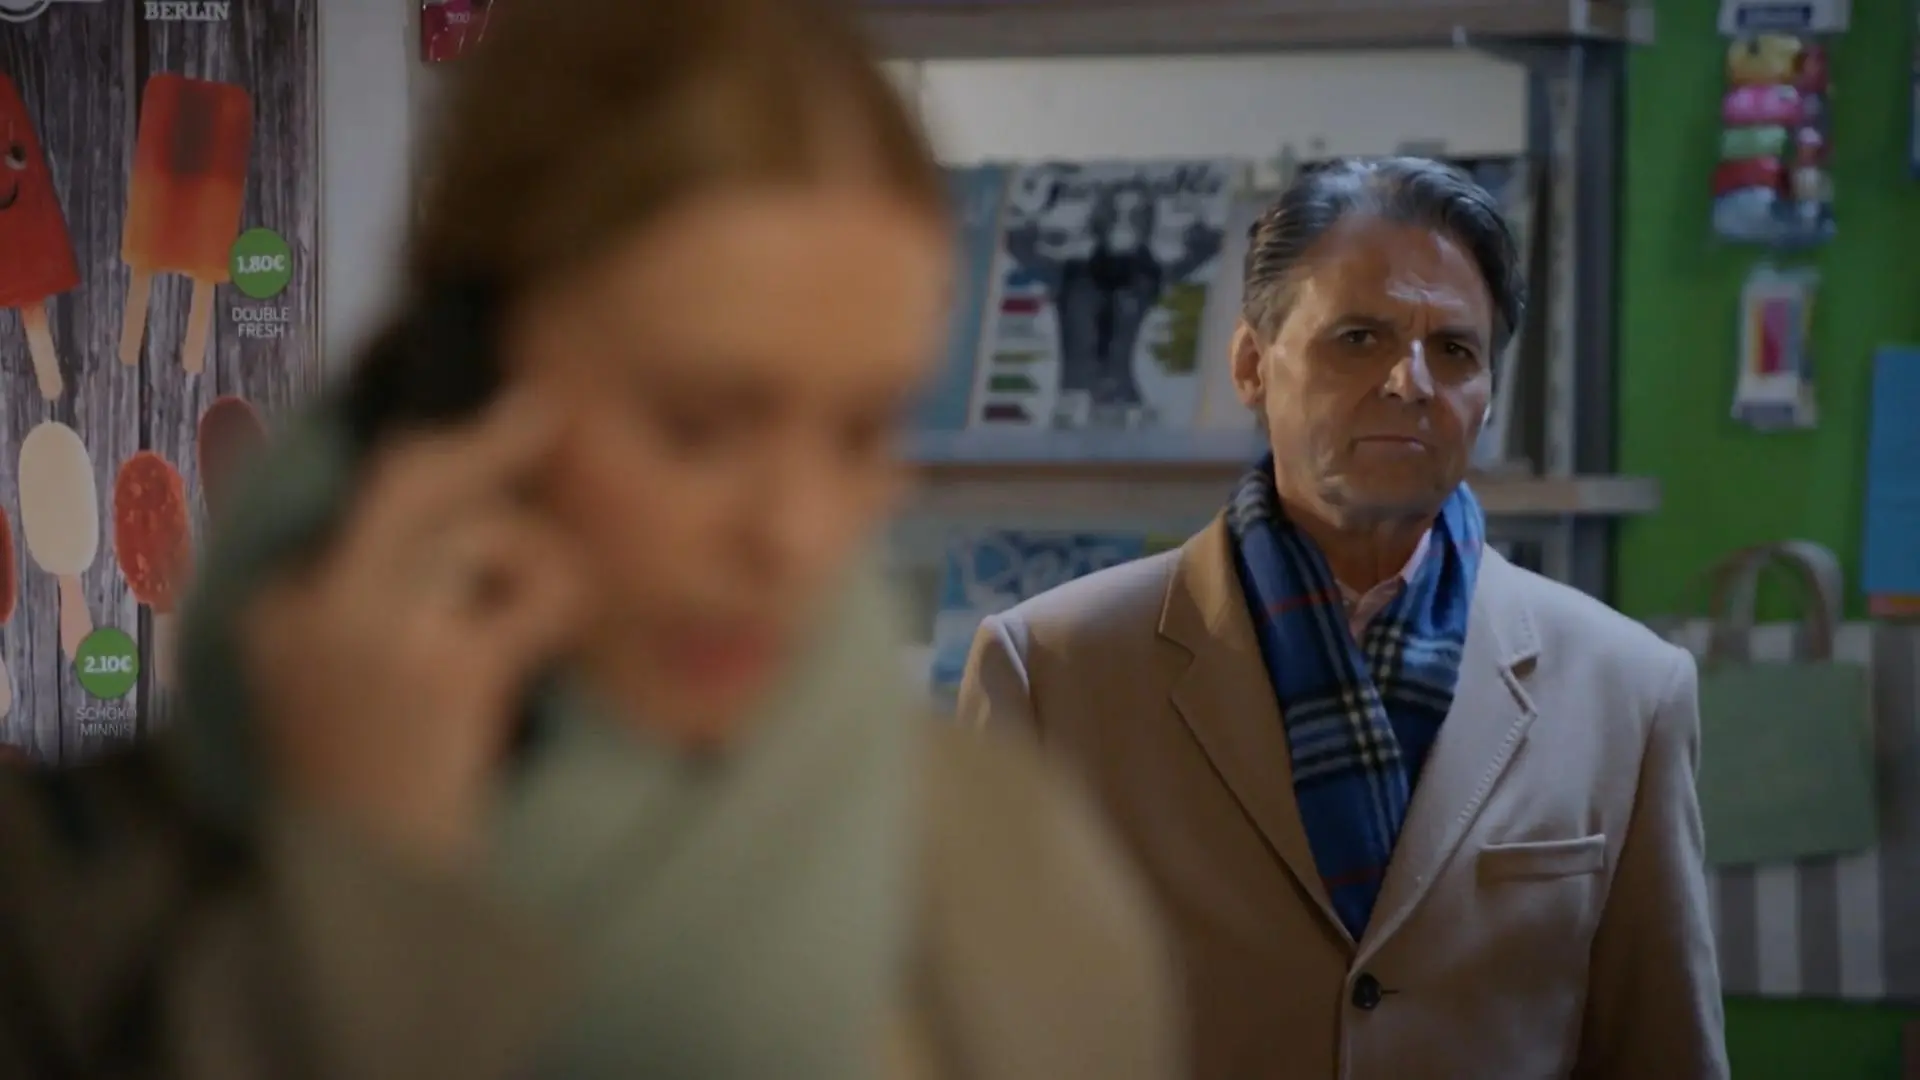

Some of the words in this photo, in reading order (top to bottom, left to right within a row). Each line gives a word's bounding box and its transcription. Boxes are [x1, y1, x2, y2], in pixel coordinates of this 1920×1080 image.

[144, 1, 230, 21] BERLIN
[232, 306, 290, 322] DOUBLE
[238, 322, 286, 339] FRESH
[83, 654, 134, 674] 2.10€
